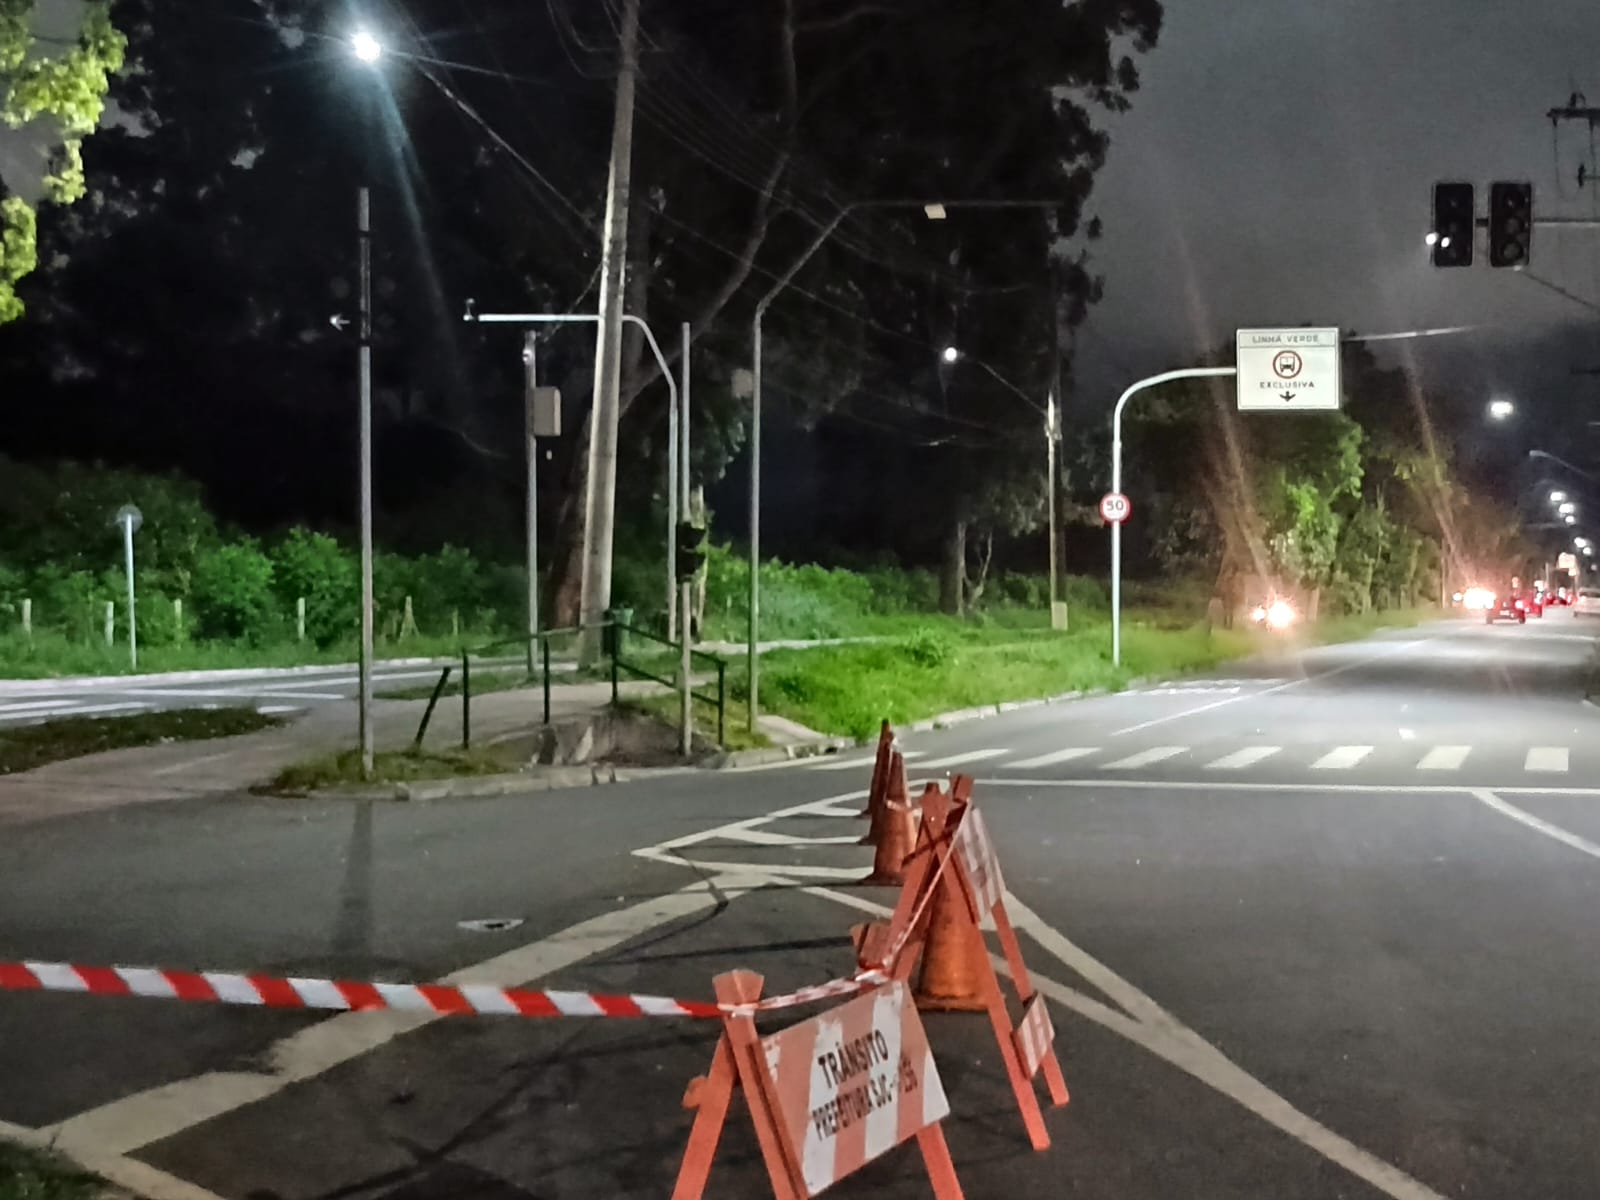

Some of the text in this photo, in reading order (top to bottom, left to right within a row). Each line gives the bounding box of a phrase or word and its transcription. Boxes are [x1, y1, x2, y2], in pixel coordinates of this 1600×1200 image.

[1252, 335, 1319, 344] LINHA VERDE
[1259, 381, 1315, 389] EXCLUSIVA
[1106, 500, 1124, 511] 50
